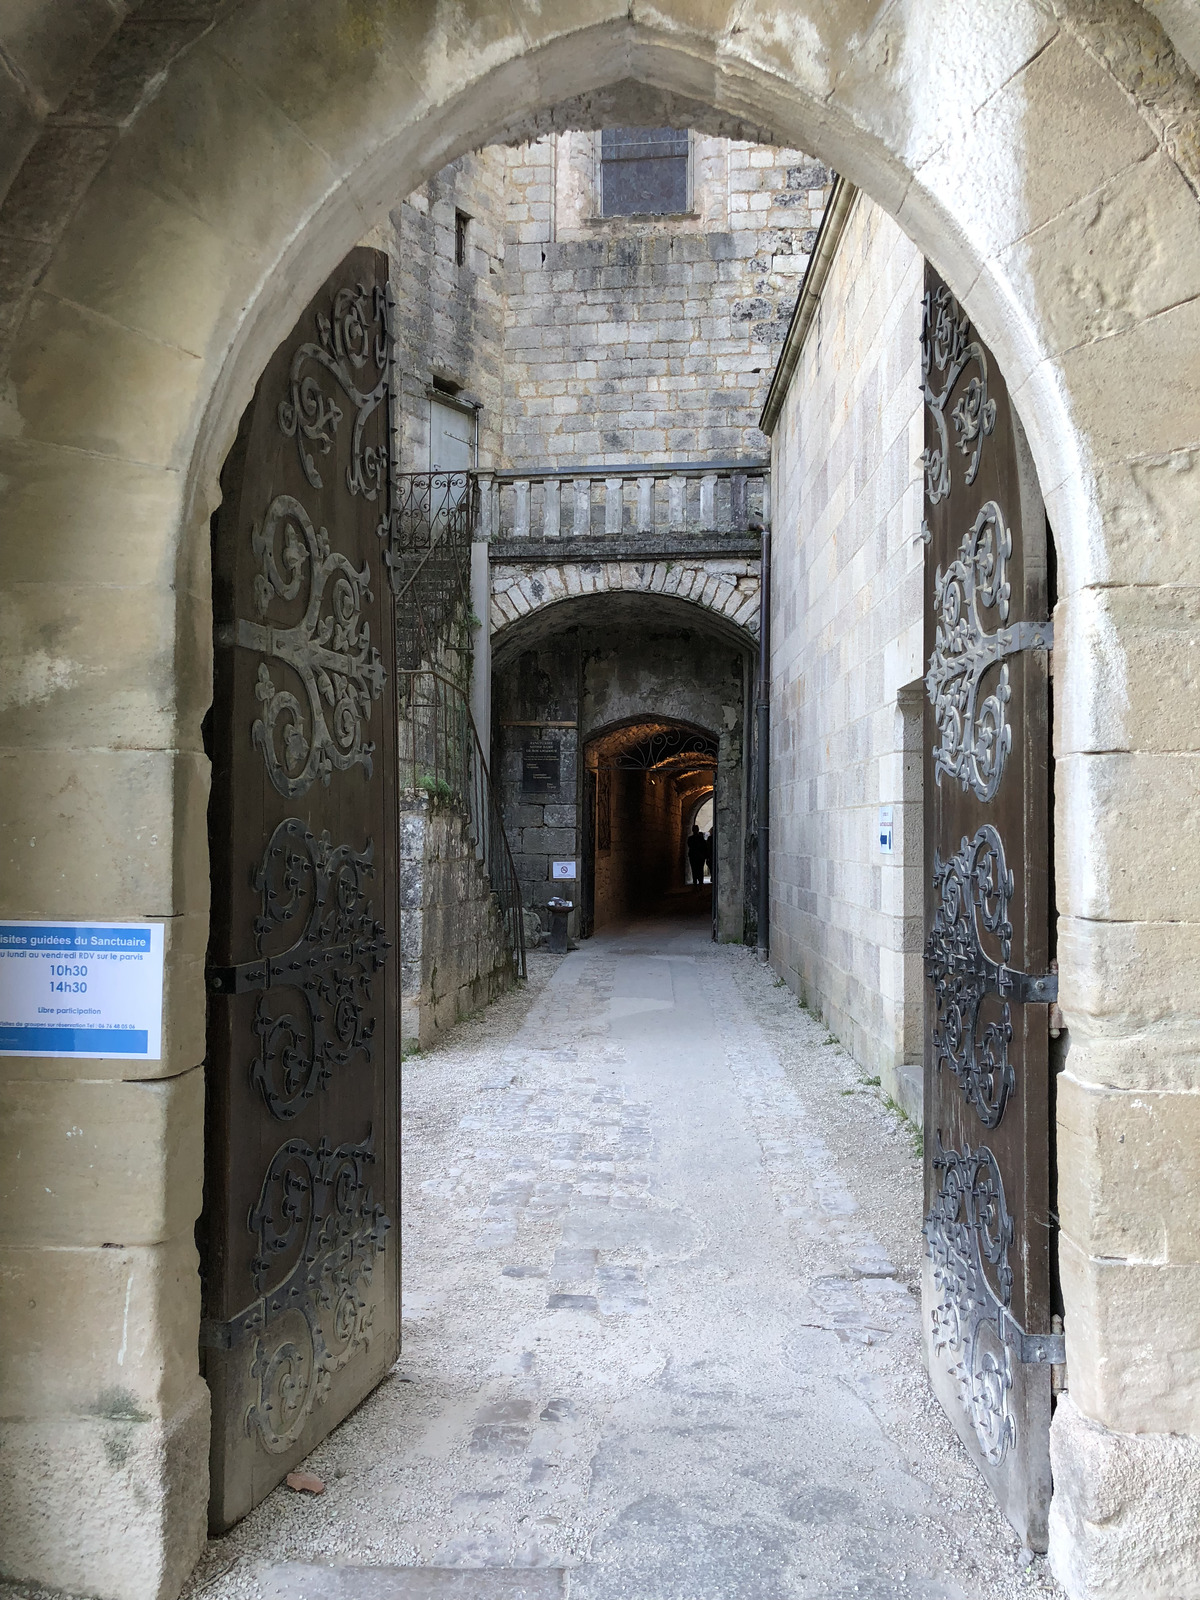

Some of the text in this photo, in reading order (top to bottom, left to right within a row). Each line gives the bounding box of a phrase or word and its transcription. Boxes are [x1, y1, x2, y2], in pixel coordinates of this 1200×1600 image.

[0, 934, 146, 947] isites guidées du Sanctuaire
[7, 950, 27, 958] lundi
[41, 951, 77, 960] vendredi
[79, 952, 95, 960] RDV
[110, 953, 118, 961] le
[120, 953, 144, 962] parvis
[50, 964, 88, 977] 10h30
[50, 981, 87, 994] 14h30
[56, 1007, 102, 1016] participation
